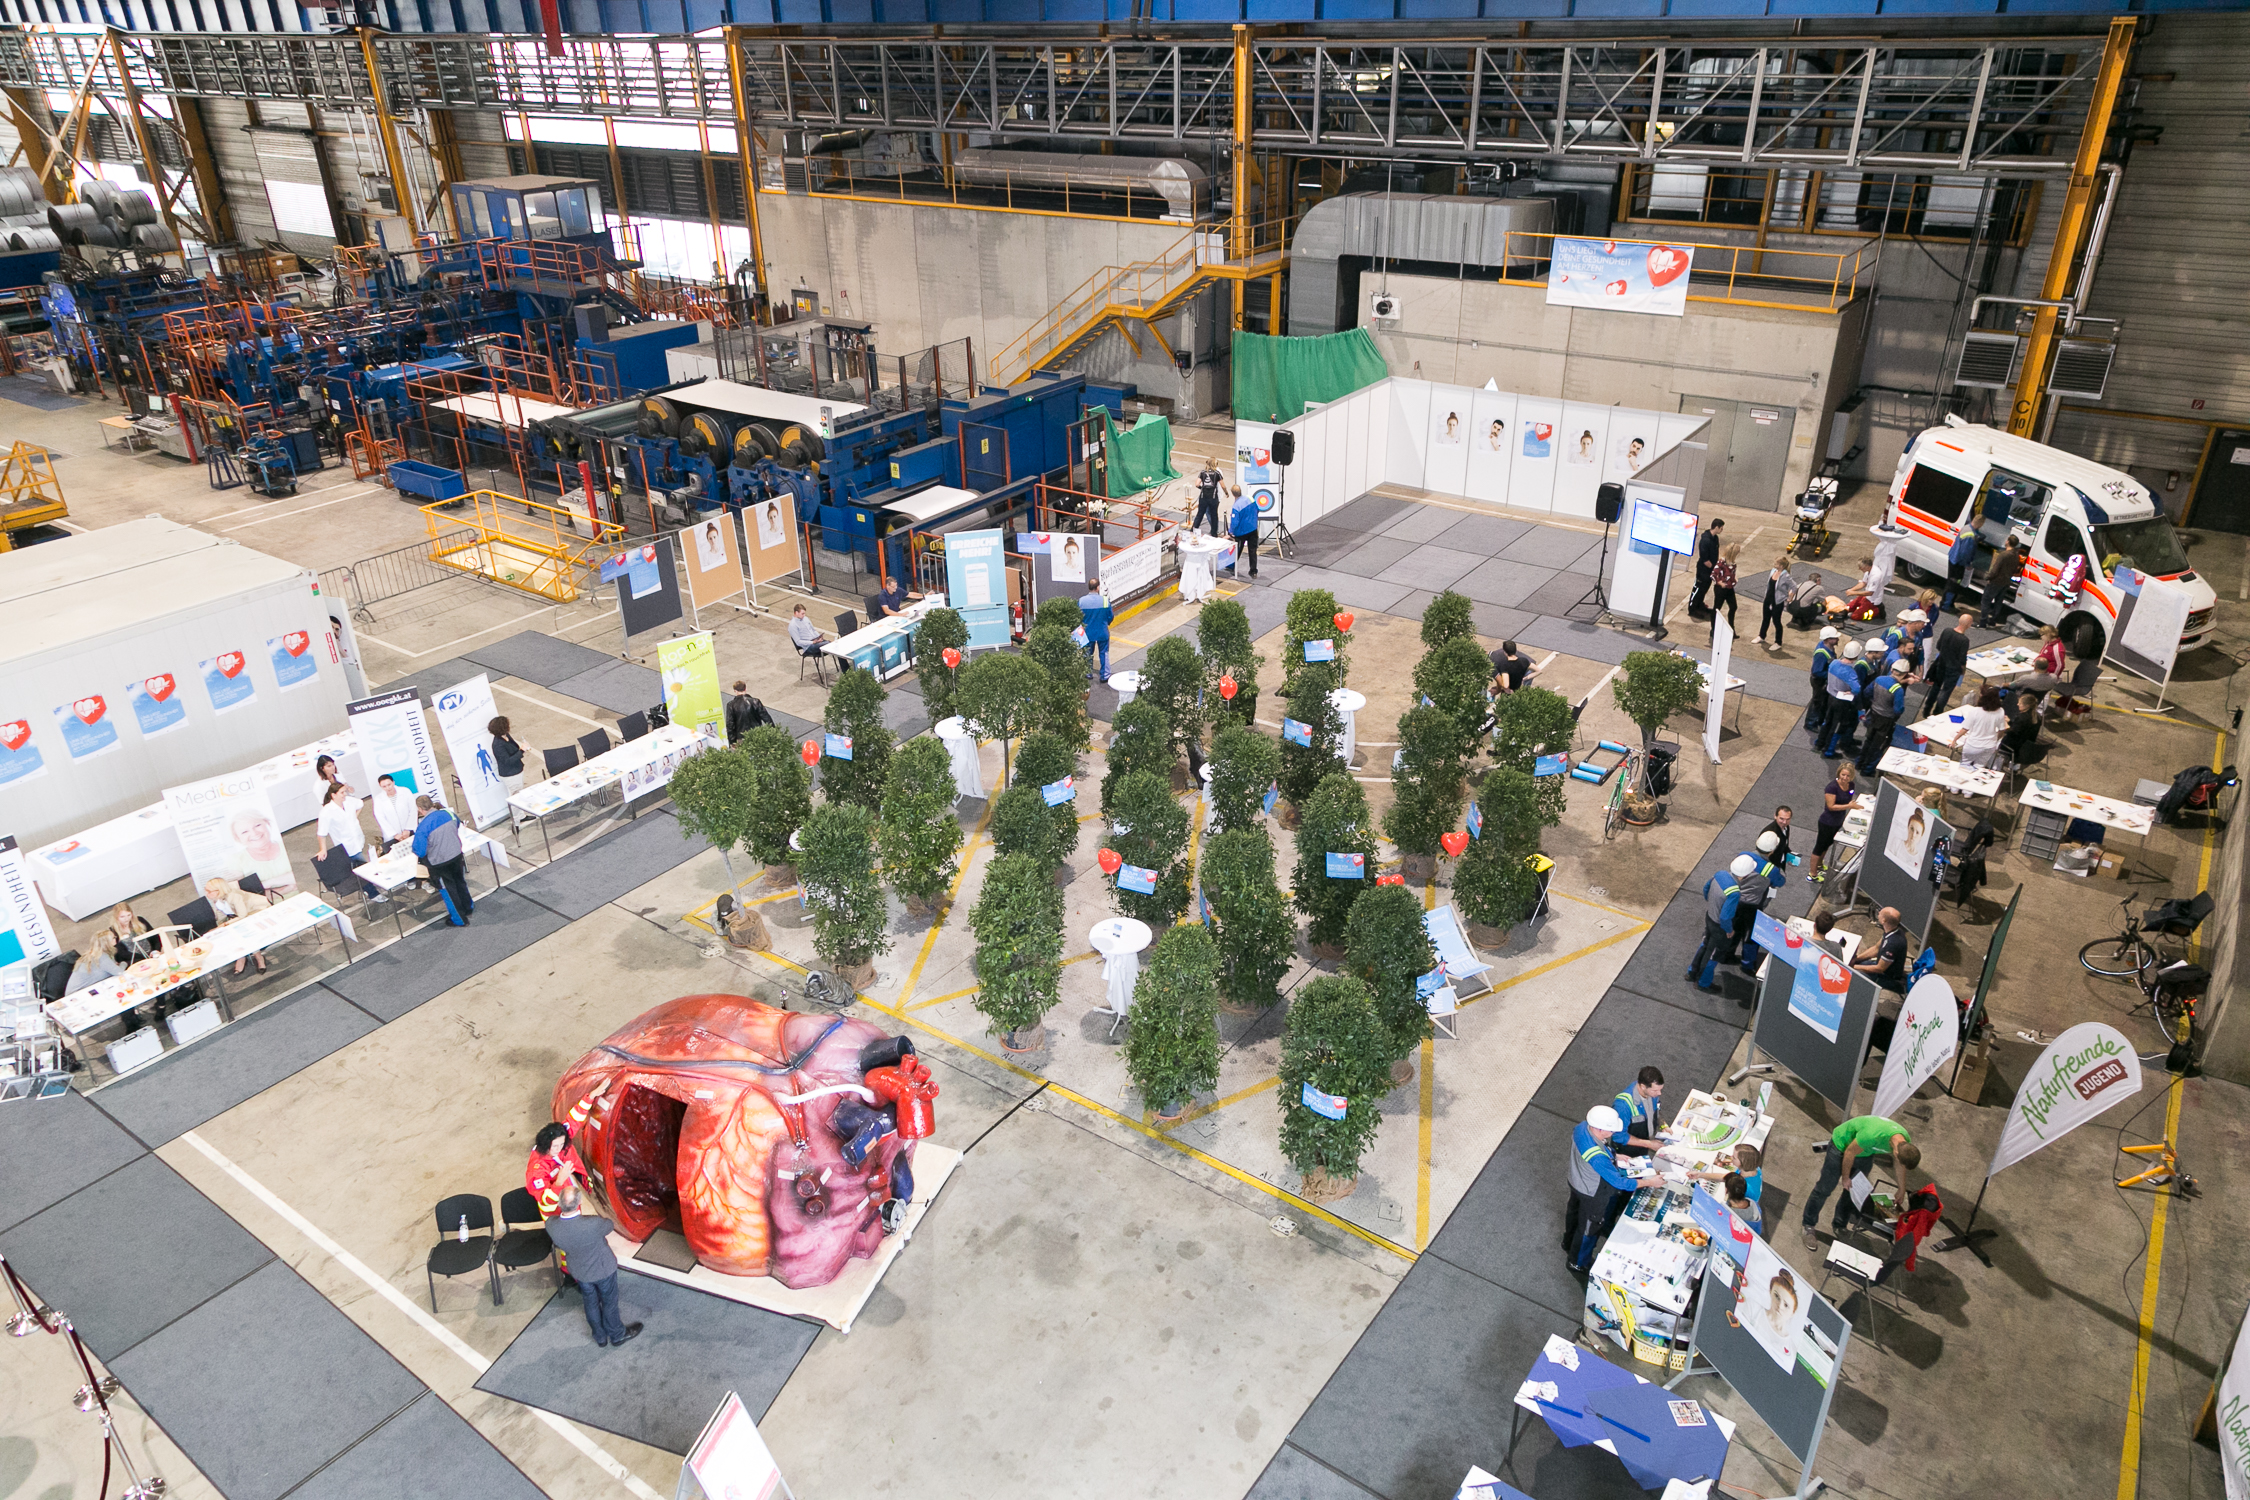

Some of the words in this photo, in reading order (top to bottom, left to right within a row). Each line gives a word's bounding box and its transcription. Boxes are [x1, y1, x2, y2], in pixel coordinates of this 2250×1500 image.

[1559, 245, 1575, 254] UNS
[1577, 247, 1598, 255] LIEGT
[1571, 263, 1604, 272] HERZEN!
[1582, 256, 1632, 266] GESUNDHEIT
[2016, 400, 2030, 414] C
[2014, 418, 2026, 429] 10
[950, 536, 999, 550] ERREICHE
[959, 547, 992, 559] MEHR!
[354, 692, 412, 712] www.ooegkk.at
[442, 694, 464, 712] PV
[406, 710, 436, 785] GESUNDHEIT
[0, 862, 46, 947] GESUNDHEIT
[1904, 1011, 1943, 1088] Naturfreunde
[2021, 1034, 2126, 1140] Naturfreunde
[2080, 1063, 2122, 1095] JUGEND
